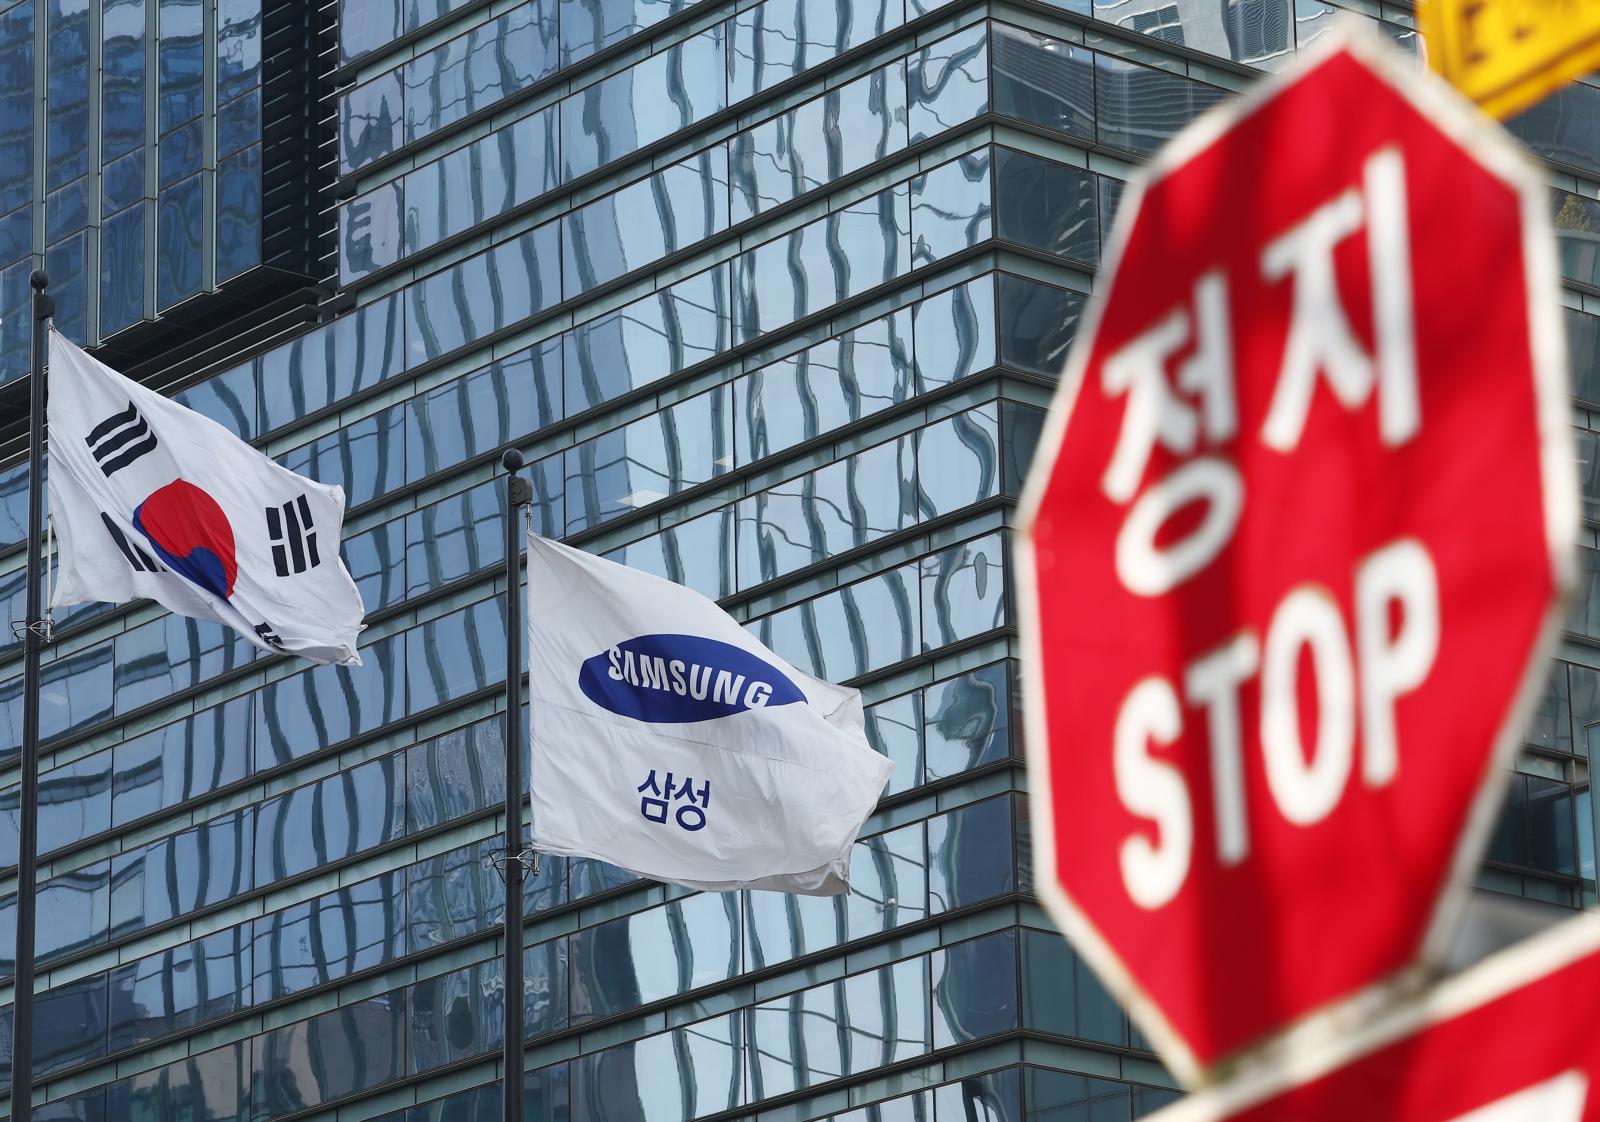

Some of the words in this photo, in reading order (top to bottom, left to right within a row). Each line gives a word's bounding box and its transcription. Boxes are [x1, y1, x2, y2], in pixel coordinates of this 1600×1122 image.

[1101, 145, 1422, 597] 정지
[608, 645, 773, 709] SAMSUNG
[1114, 538, 1441, 911] STOP
[638, 769, 710, 831] 삼성
